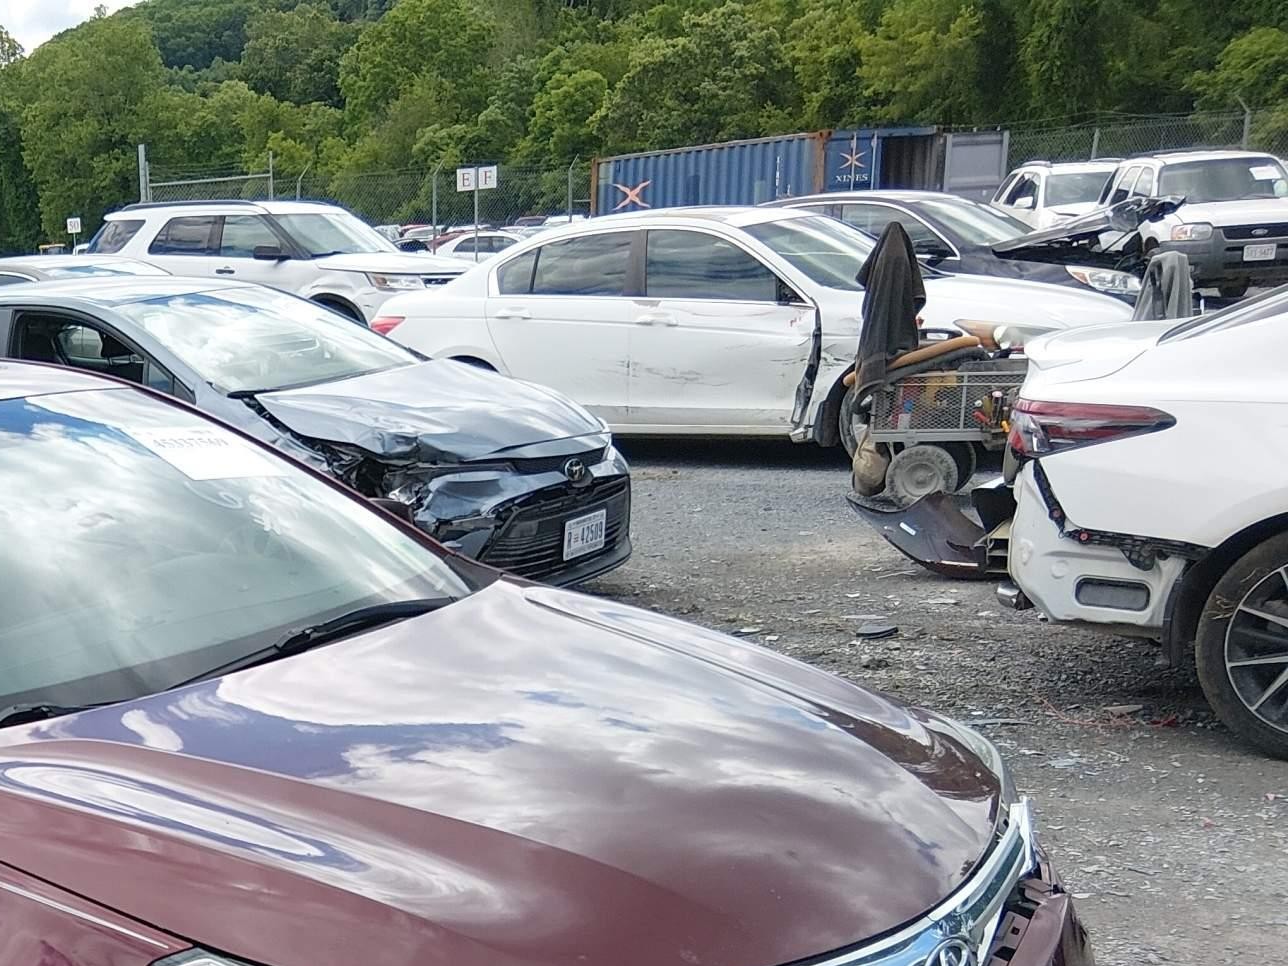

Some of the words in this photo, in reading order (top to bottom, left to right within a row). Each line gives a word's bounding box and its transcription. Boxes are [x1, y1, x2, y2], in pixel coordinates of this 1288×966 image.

[462, 172, 471, 186] E
[483, 170, 492, 185] F
[581, 520, 603, 545] 42509
